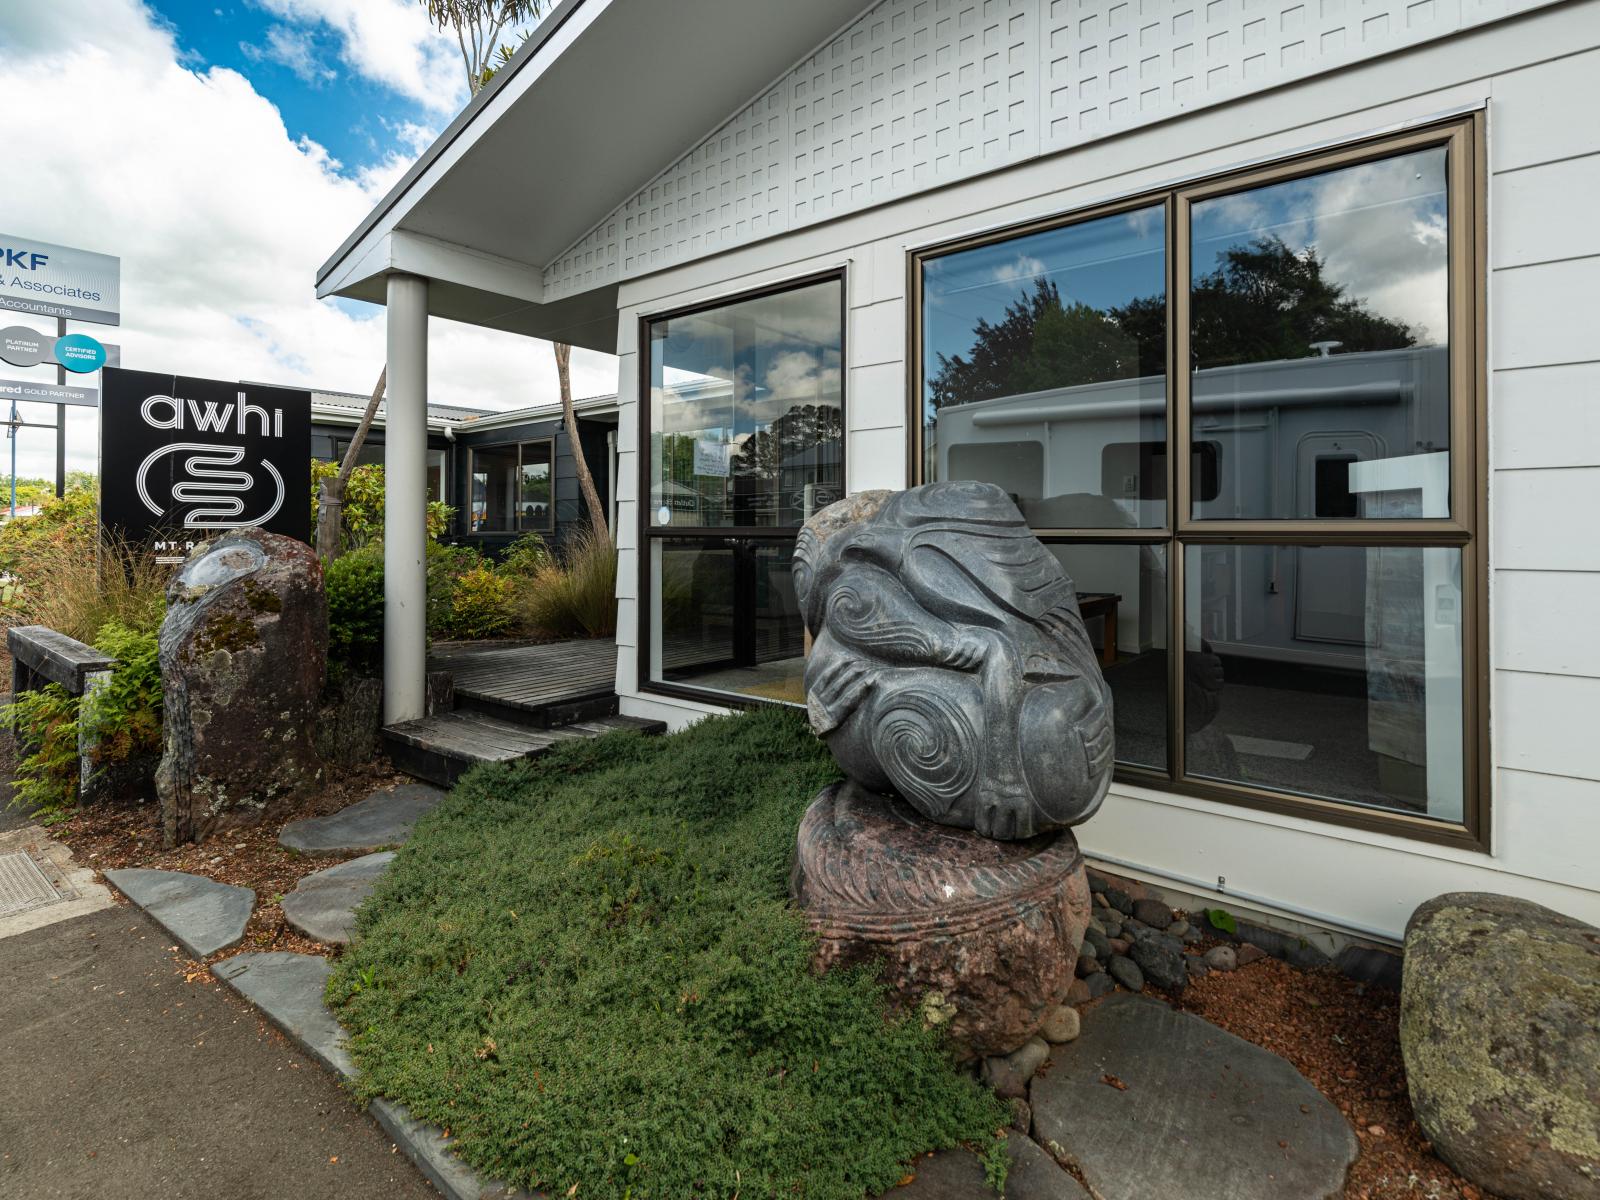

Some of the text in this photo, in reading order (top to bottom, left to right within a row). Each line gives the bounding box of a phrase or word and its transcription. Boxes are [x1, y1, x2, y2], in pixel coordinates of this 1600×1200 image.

[0, 248, 49, 271] KF
[10, 276, 100, 301] Associates
[0, 297, 73, 316] Accountants
[5, 338, 39, 347] PLATINUM
[6, 344, 38, 353] PARTNER
[64, 346, 97, 355] CERTIFIED
[65, 352, 97, 361] ADVISORS
[24, 388, 48, 396] GOLD
[49, 391, 85, 399] PARTNER
[140, 391, 283, 438] awhi
